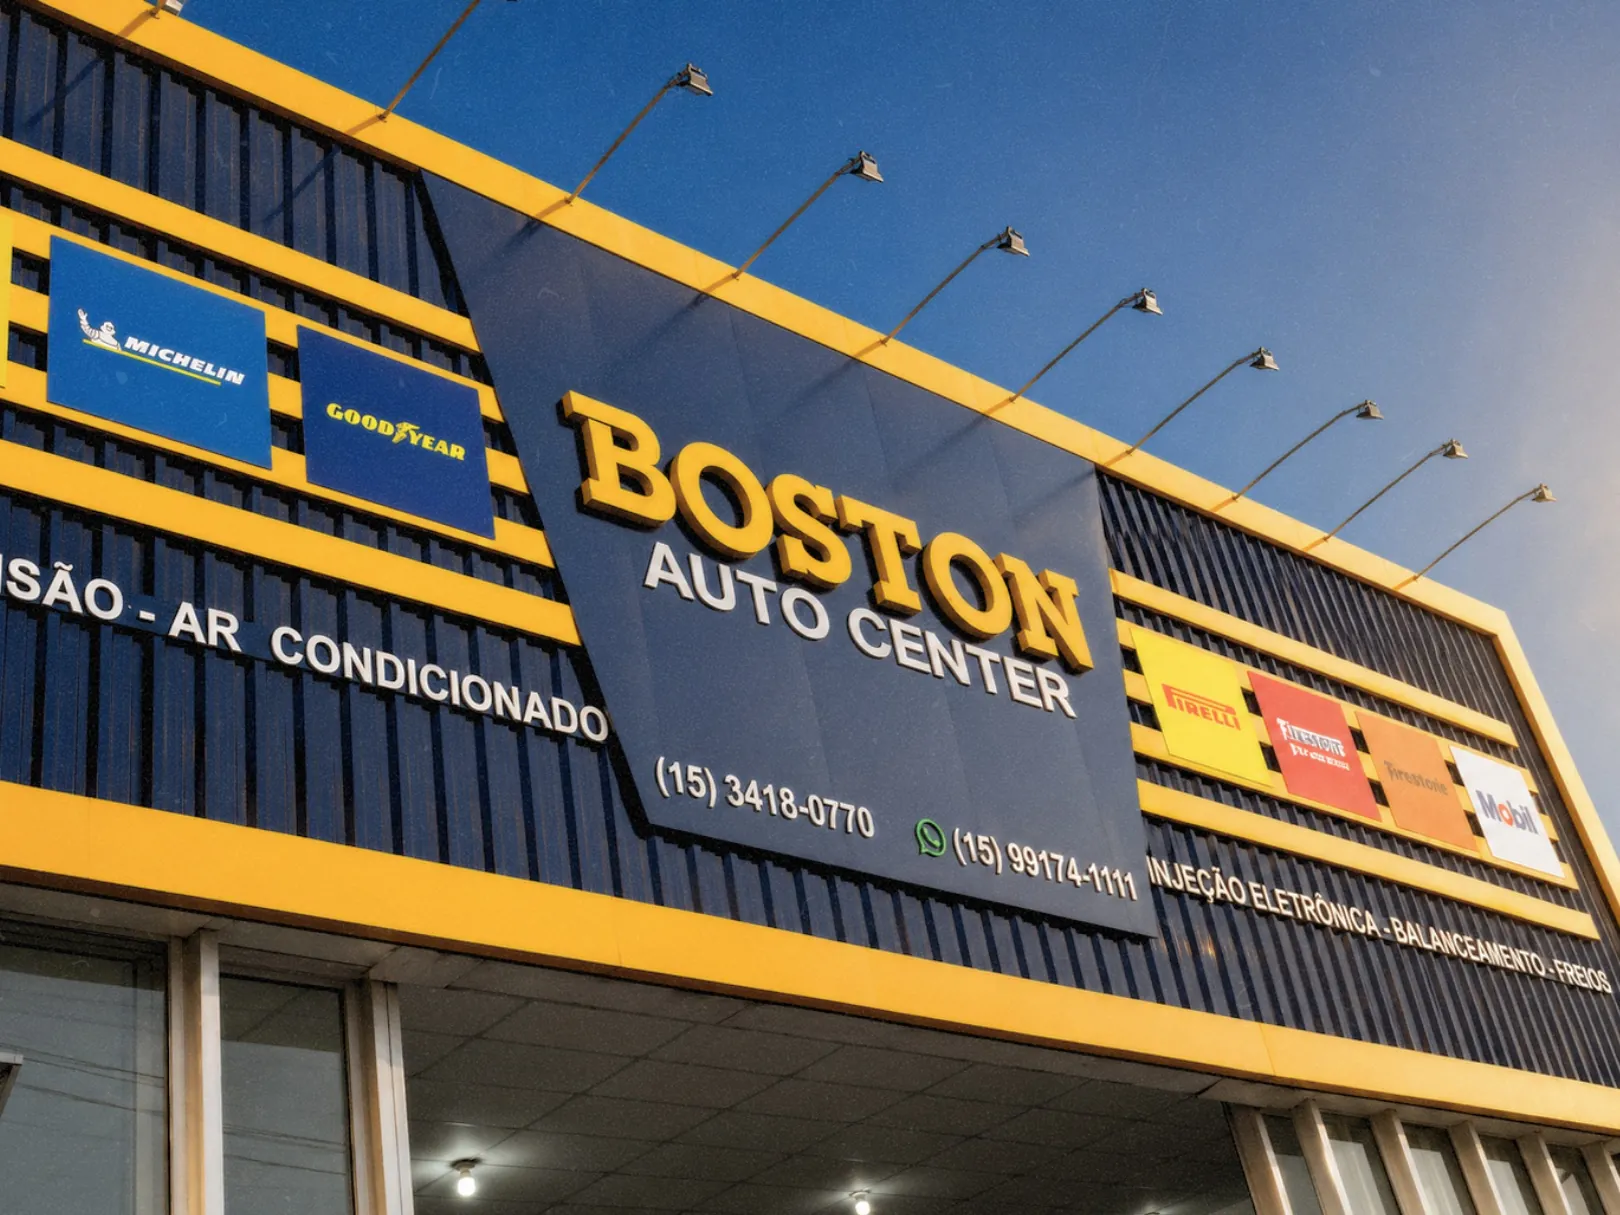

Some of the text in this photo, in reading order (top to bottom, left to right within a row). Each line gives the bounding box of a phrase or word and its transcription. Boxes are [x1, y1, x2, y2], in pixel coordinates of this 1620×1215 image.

[124, 336, 246, 386] MICHELIN
[561, 389, 1095, 674] BOSTON
[0, 553, 124, 621] SÃO
[168, 601, 243, 653] AR
[269, 625, 610, 743] CONDICIONADO
[643, 541, 1078, 719] AUTO CENTER
[1161, 683, 1241, 731] PIRELLI
[655, 756, 875, 839] (15) 3418-0770
[1475, 789, 1539, 835] Mobil
[952, 827, 1138, 901] (15) 99174-1111
[1146, 855, 1247, 905] INJEÇÃO
[1247, 879, 1382, 938] ELETRÔNICA
[1389, 916, 1546, 977] BALANCEAMENTO
[1553, 958, 1612, 995] FREIOS
